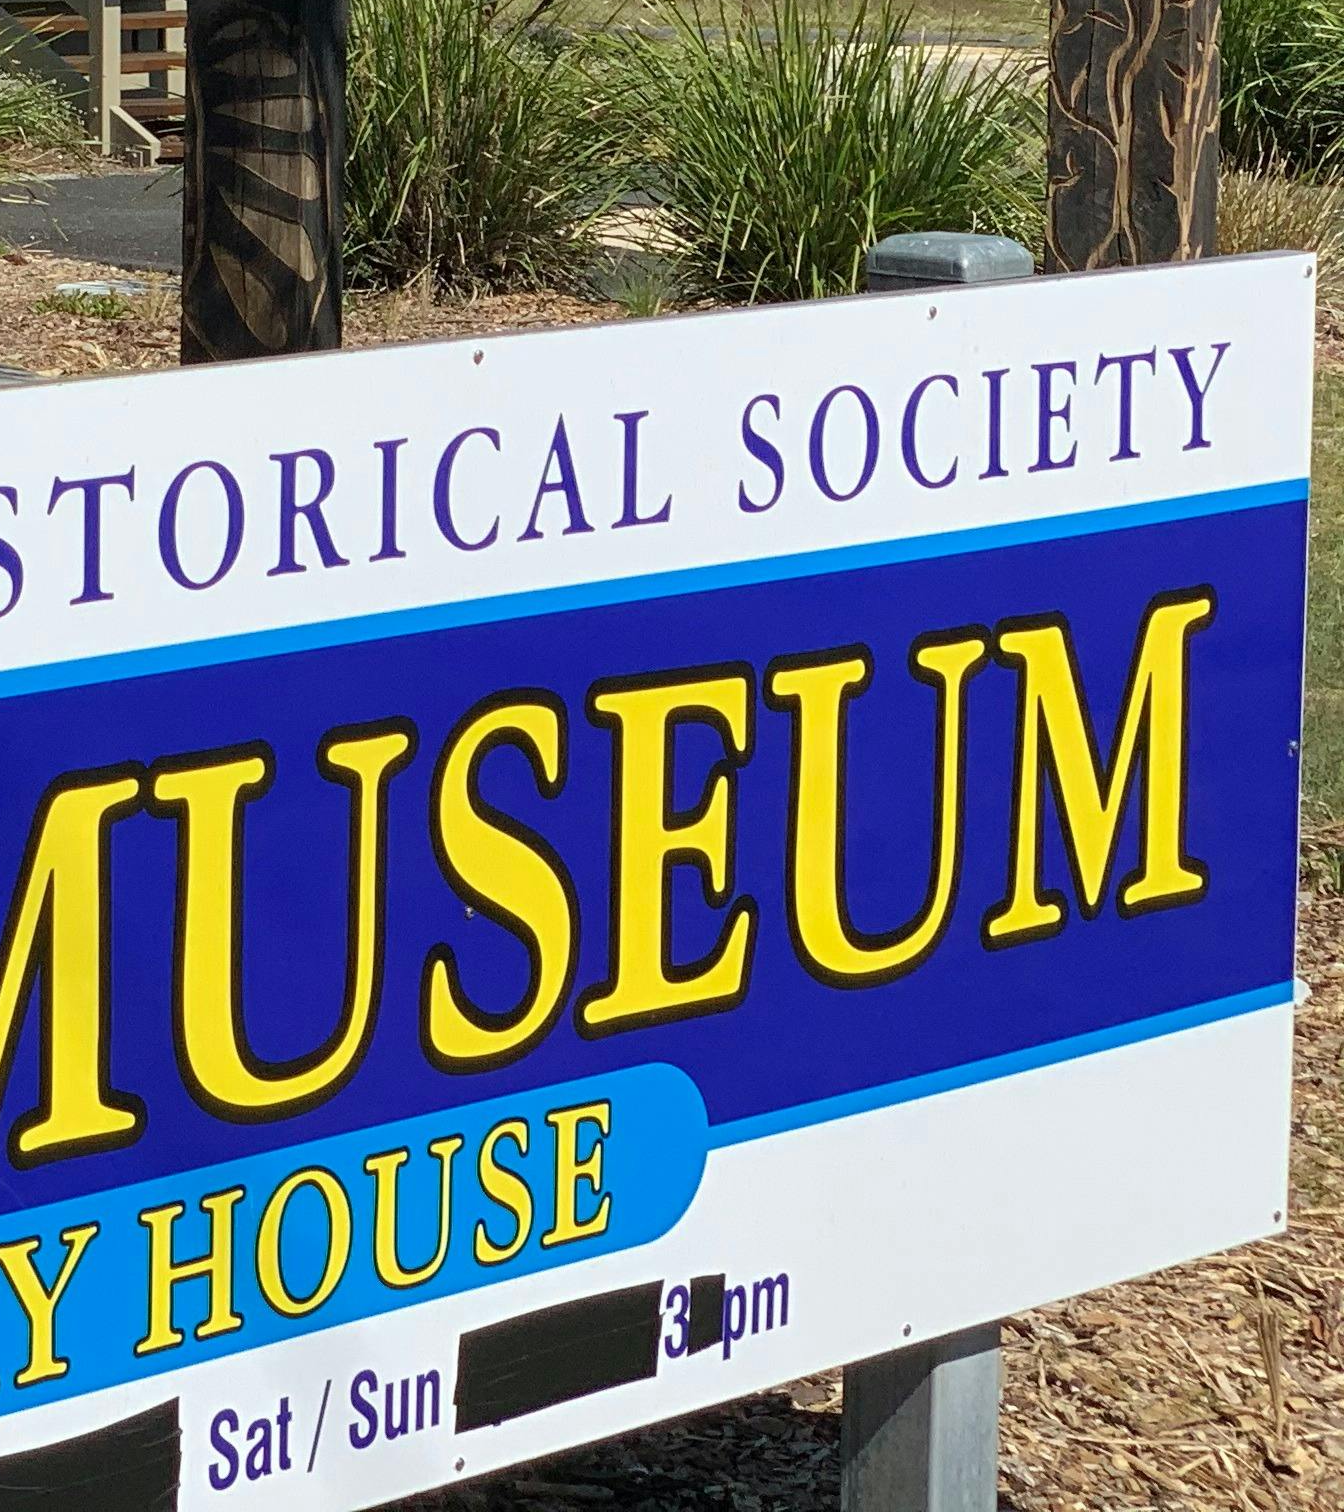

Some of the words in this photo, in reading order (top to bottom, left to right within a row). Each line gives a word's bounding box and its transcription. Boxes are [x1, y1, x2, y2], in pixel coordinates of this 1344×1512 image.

[737, 341, 1234, 515] SOCIETY
[133, 1101, 610, 1356] HOUSE
[207, 1397, 293, 1492] Sat
[348, 1368, 441, 1451] Sun
